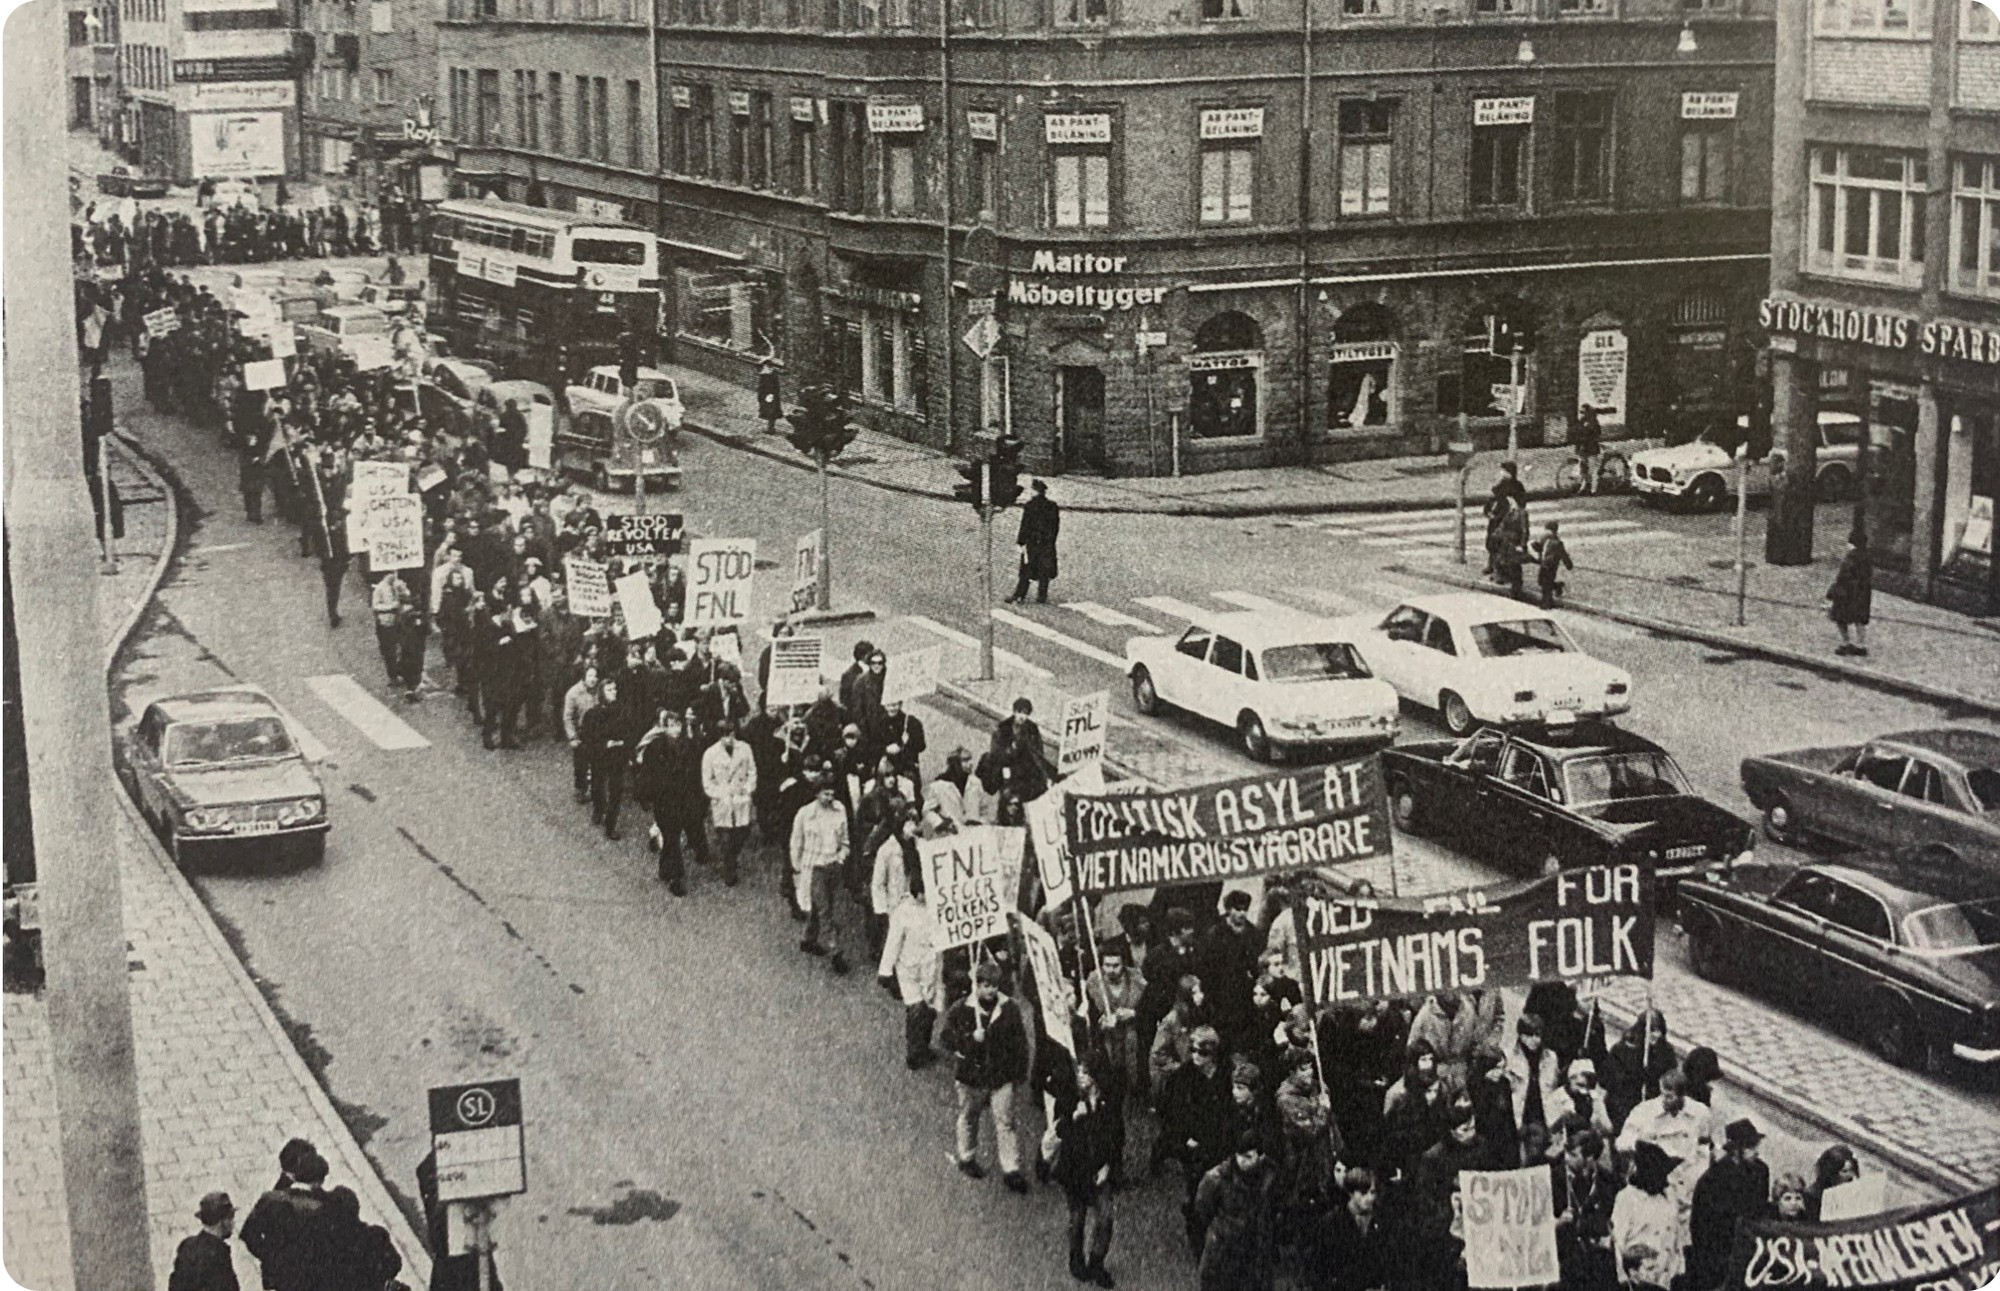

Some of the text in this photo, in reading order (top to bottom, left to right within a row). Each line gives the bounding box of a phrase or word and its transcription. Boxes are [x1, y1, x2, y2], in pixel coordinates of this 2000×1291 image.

[1032, 250, 1127, 273] Mattor
[1008, 278, 1168, 311] Möbeltyger
[1759, 299, 1909, 349] STOCKHOLMS
[607, 527, 683, 542] REVOLTEN
[626, 542, 656, 555] USA
[697, 545, 752, 585] STÖD
[695, 590, 743, 620] FNL
[1076, 762, 1363, 843] POLITISK ASYL ÅT
[931, 843, 998, 886] FNL
[1076, 815, 1374, 891] VIETNAMKRIGSVÄGRARE
[937, 894, 1000, 925] FOLKENS
[946, 915, 997, 944] HOPP
[1309, 915, 1638, 1001] VIETNAMS FOLK
[464, 1097, 488, 1117] SL
